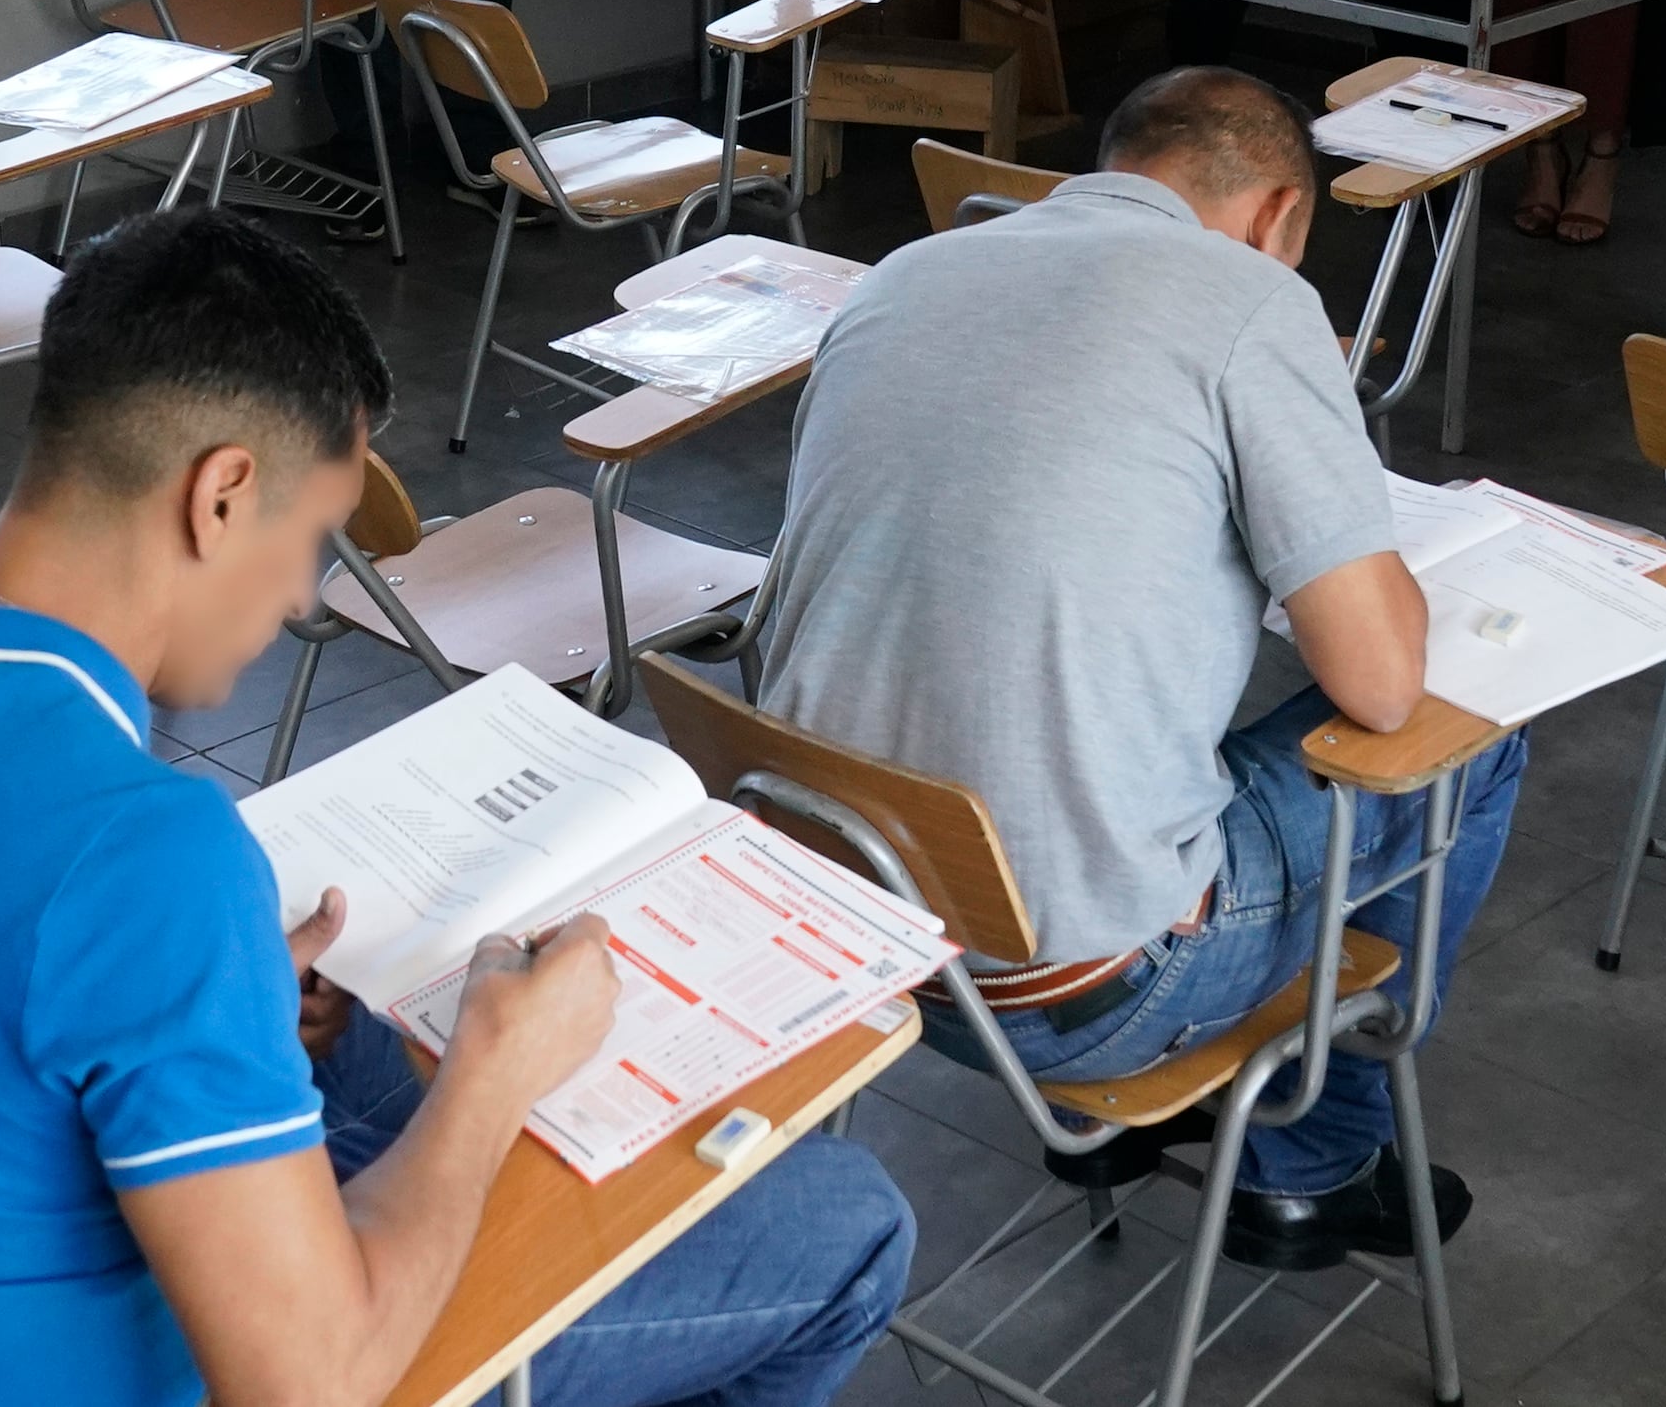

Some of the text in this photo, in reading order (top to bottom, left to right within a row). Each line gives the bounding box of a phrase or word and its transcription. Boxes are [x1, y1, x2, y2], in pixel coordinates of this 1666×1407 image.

[738, 850, 803, 899] COMPETENCIA
[620, 1125, 657, 1154] PAES
[659, 1084, 725, 1129] REGULAR
[735, 1036, 800, 1079] PROCESO
[801, 1025, 821, 1041] DE
